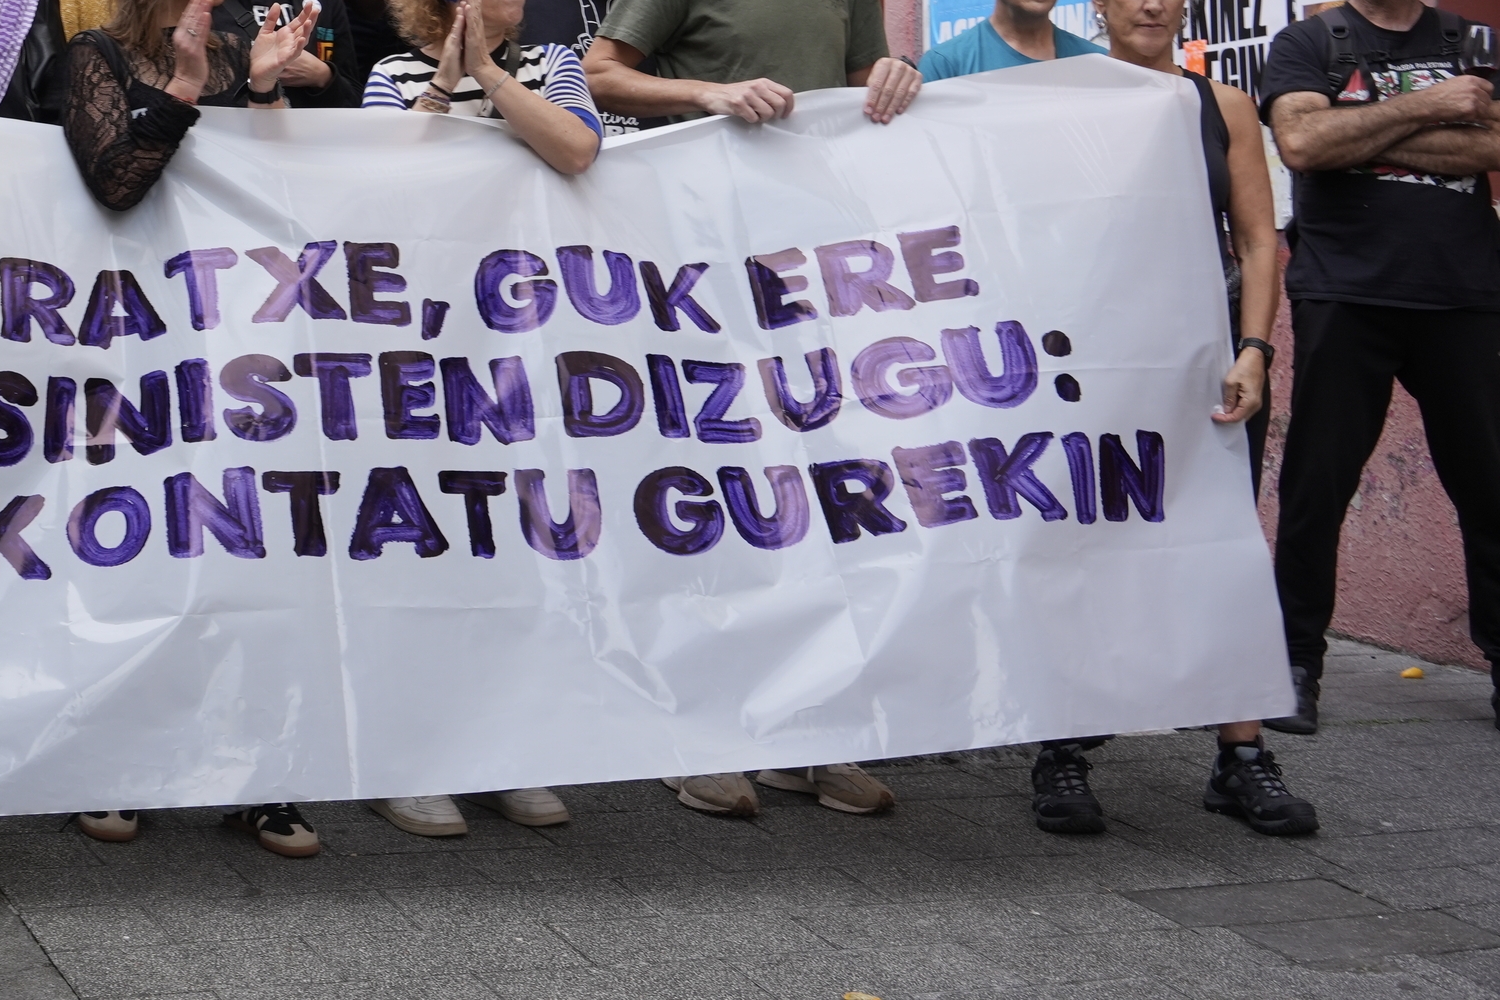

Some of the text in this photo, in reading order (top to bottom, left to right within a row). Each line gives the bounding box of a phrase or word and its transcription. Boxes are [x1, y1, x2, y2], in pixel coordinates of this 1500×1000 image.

[599, 111, 639, 126] tina
[475, 245, 722, 333] GUK
[745, 225, 979, 330] ERE
[555, 320, 1082, 444] DIZUGU:
[633, 430, 1166, 557] GUREKIN
